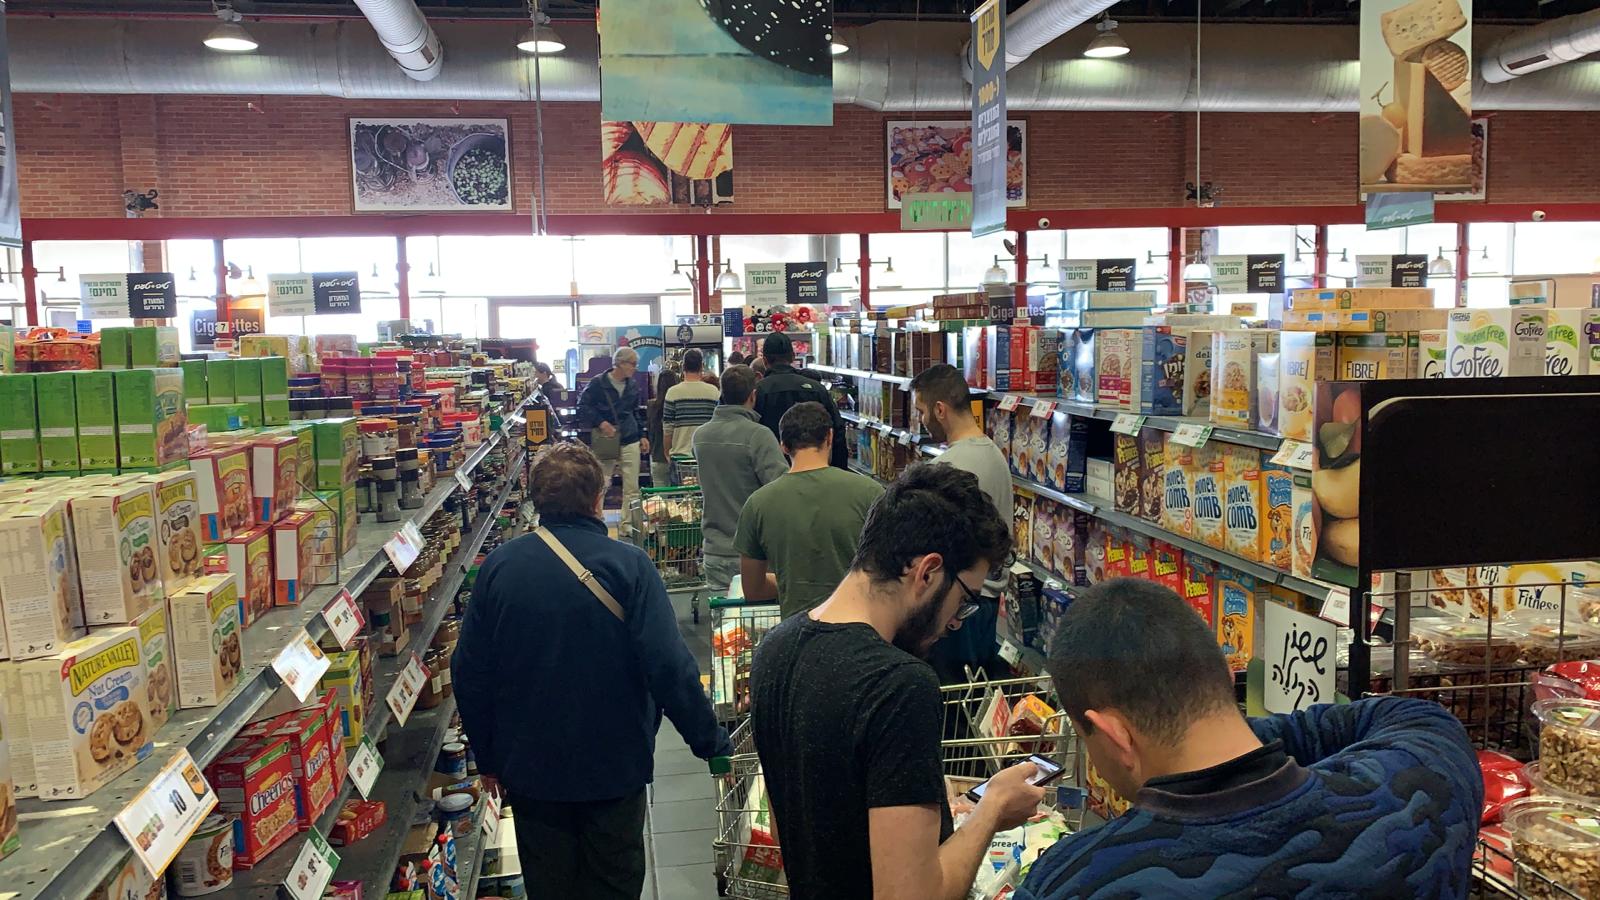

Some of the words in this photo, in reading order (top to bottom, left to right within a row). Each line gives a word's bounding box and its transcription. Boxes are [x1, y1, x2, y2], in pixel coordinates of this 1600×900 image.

[220, 323, 226, 332] 7
[702, 314, 708, 322] 9
[1486, 325, 1506, 341] free
[1166, 487, 1190, 510] COMB
[1194, 496, 1222, 519] COMB
[1227, 504, 1258, 530] COMB
[72, 656, 107, 692] NATURE
[106, 641, 136, 664] VALLEY
[88, 682, 104, 698] Nut
[106, 672, 132, 691] Cream
[169, 789, 187, 815] 10
[250, 772, 294, 816] Cheerios
